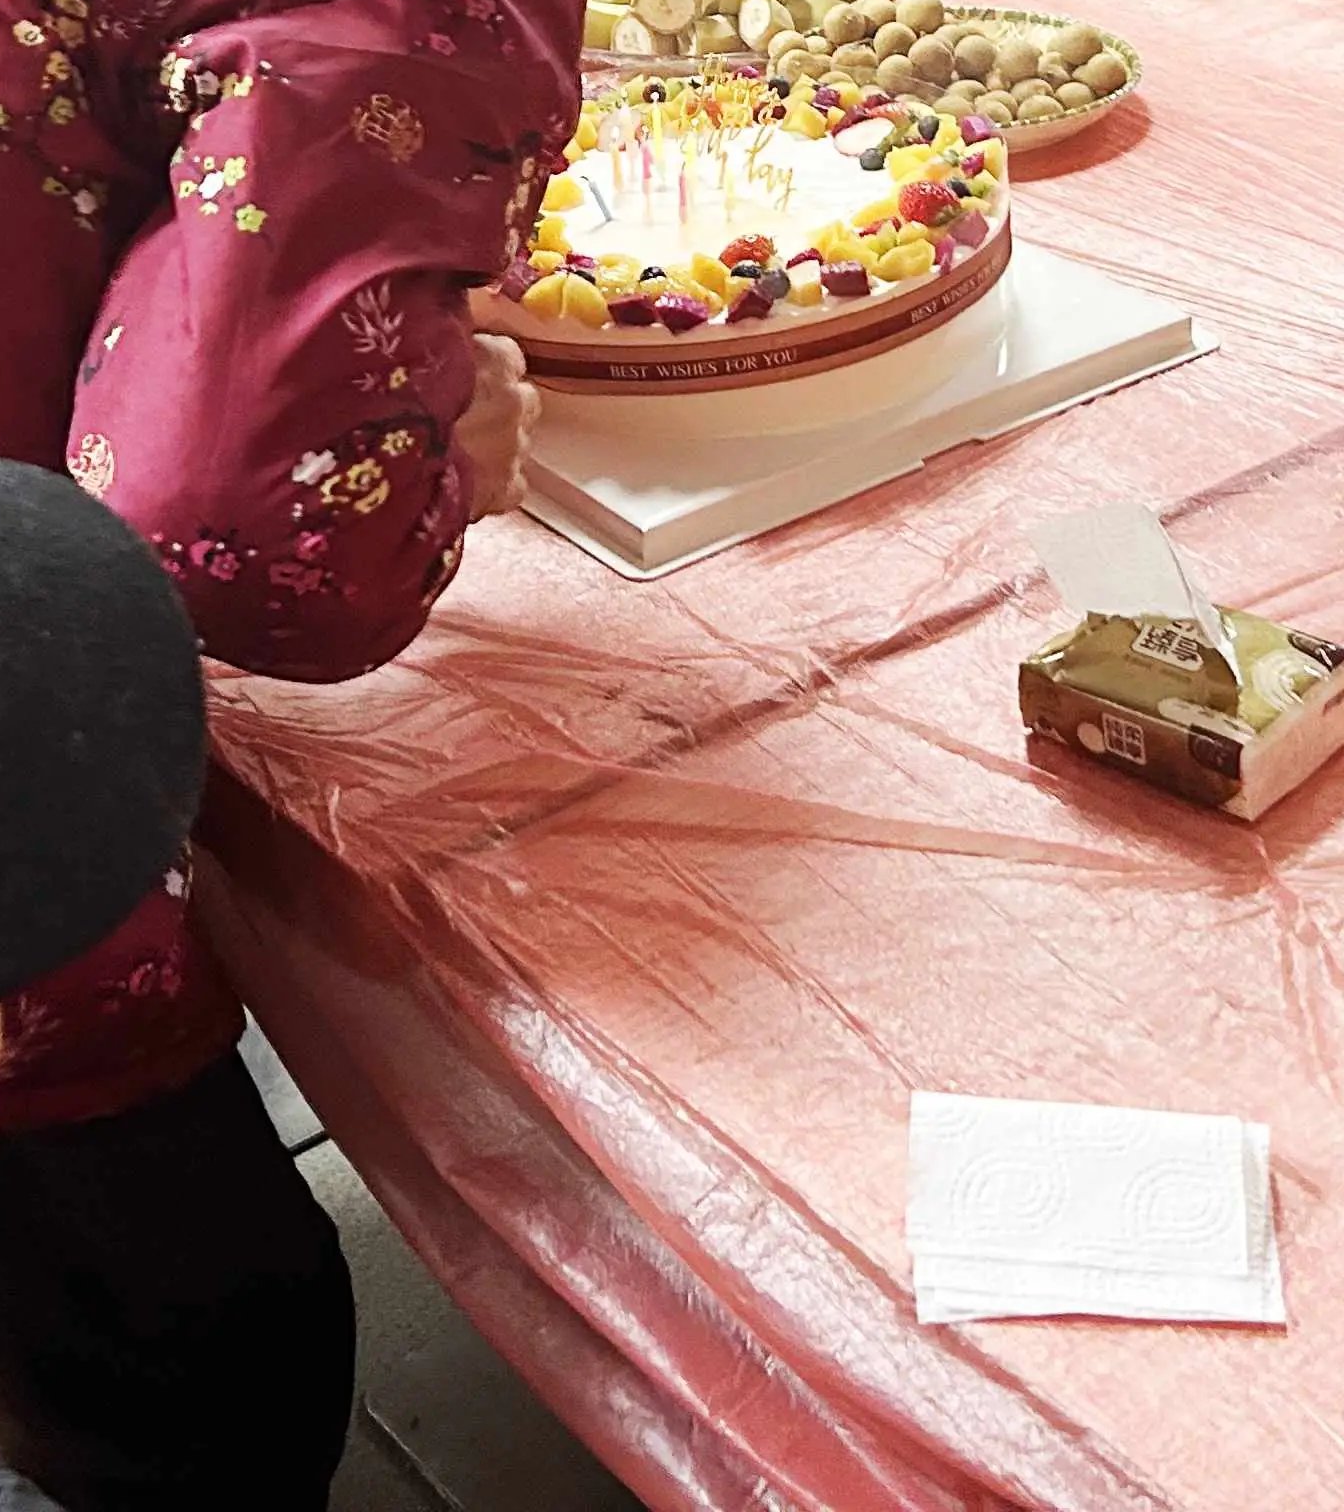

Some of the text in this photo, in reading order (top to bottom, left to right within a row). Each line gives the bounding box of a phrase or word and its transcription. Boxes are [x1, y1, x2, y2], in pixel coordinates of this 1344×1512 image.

[609, 348, 798, 378] BEST WISHES FOR YOU
